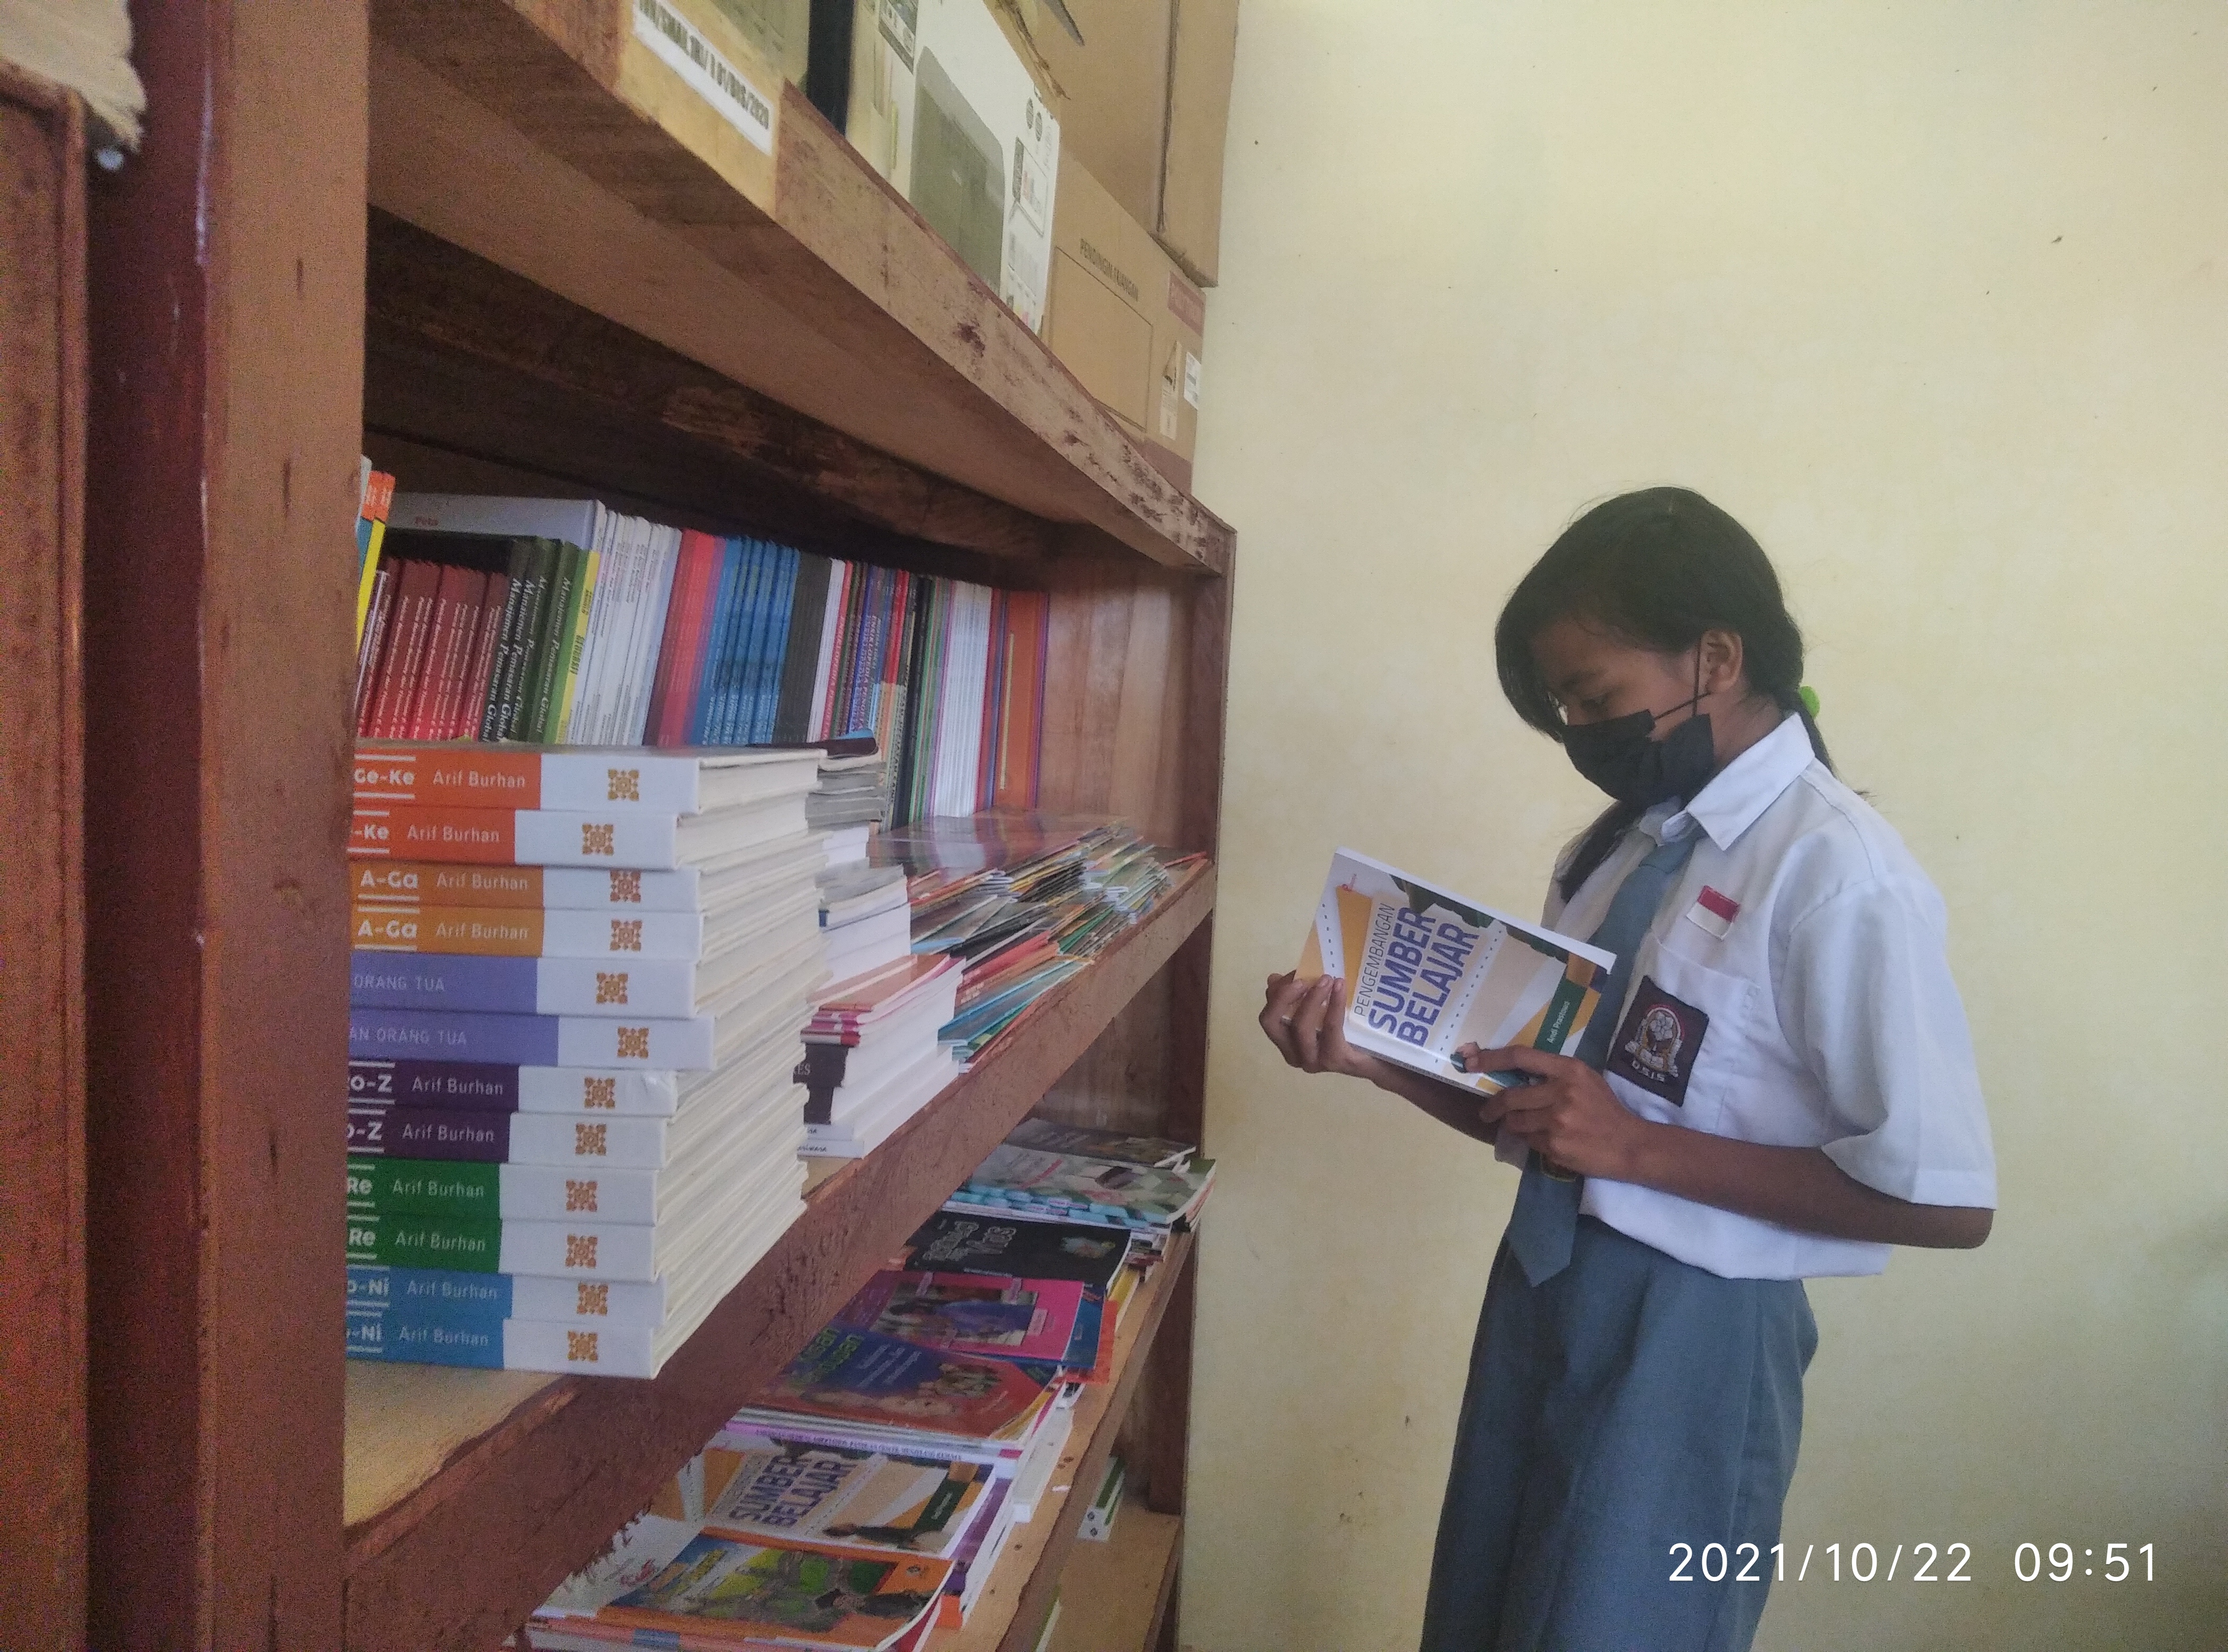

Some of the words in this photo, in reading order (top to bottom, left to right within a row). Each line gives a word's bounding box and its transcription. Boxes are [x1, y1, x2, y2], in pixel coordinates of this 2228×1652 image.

[503, 578, 523, 641] Manajemen
[489, 643, 509, 702] Pemasaran
[433, 769, 462, 786] Arif
[469, 771, 526, 788] Burhan
[352, 824, 390, 840] -Ke
[407, 825, 436, 841] Arif
[443, 827, 500, 843] Burhan
[360, 871, 418, 888] A-Ga
[437, 872, 465, 889] Arif
[472, 874, 528, 891] Burhan
[357, 920, 417, 938] A-Ga
[436, 921, 465, 938] Arif
[471, 923, 528, 940] Burhan
[1354, 903, 1395, 1017] PENGEMBANGAN
[1368, 906, 1436, 1036] SUMBER
[354, 976, 407, 991] ORANG
[416, 977, 445, 992] TUA
[1397, 922, 1479, 1047] BELAJAR
[376, 1029, 429, 1045] ORANG
[438, 1030, 467, 1045] TUA
[1546, 1028, 1559, 1044] Andi
[348, 1074, 393, 1093] o-Z
[412, 1075, 442, 1092] Arif
[447, 1078, 503, 1095] Burhan
[402, 1123, 432, 1140] Arif
[438, 1125, 493, 1143] Burhan
[393, 1179, 421, 1195] Arif
[428, 1181, 484, 1198] Burhan
[349, 1229, 376, 1246] Re
[395, 1232, 424, 1247] Arif
[430, 1235, 486, 1253] Burhan
[407, 1279, 436, 1297] Arif
[442, 1281, 498, 1299] Burhan
[346, 1323, 382, 1342] -Ni
[399, 1324, 428, 1342] Arif
[434, 1327, 489, 1346] Burhan
[729, 1453, 812, 1521] SUMBER
[761, 1459, 860, 1527] BELAJAR
